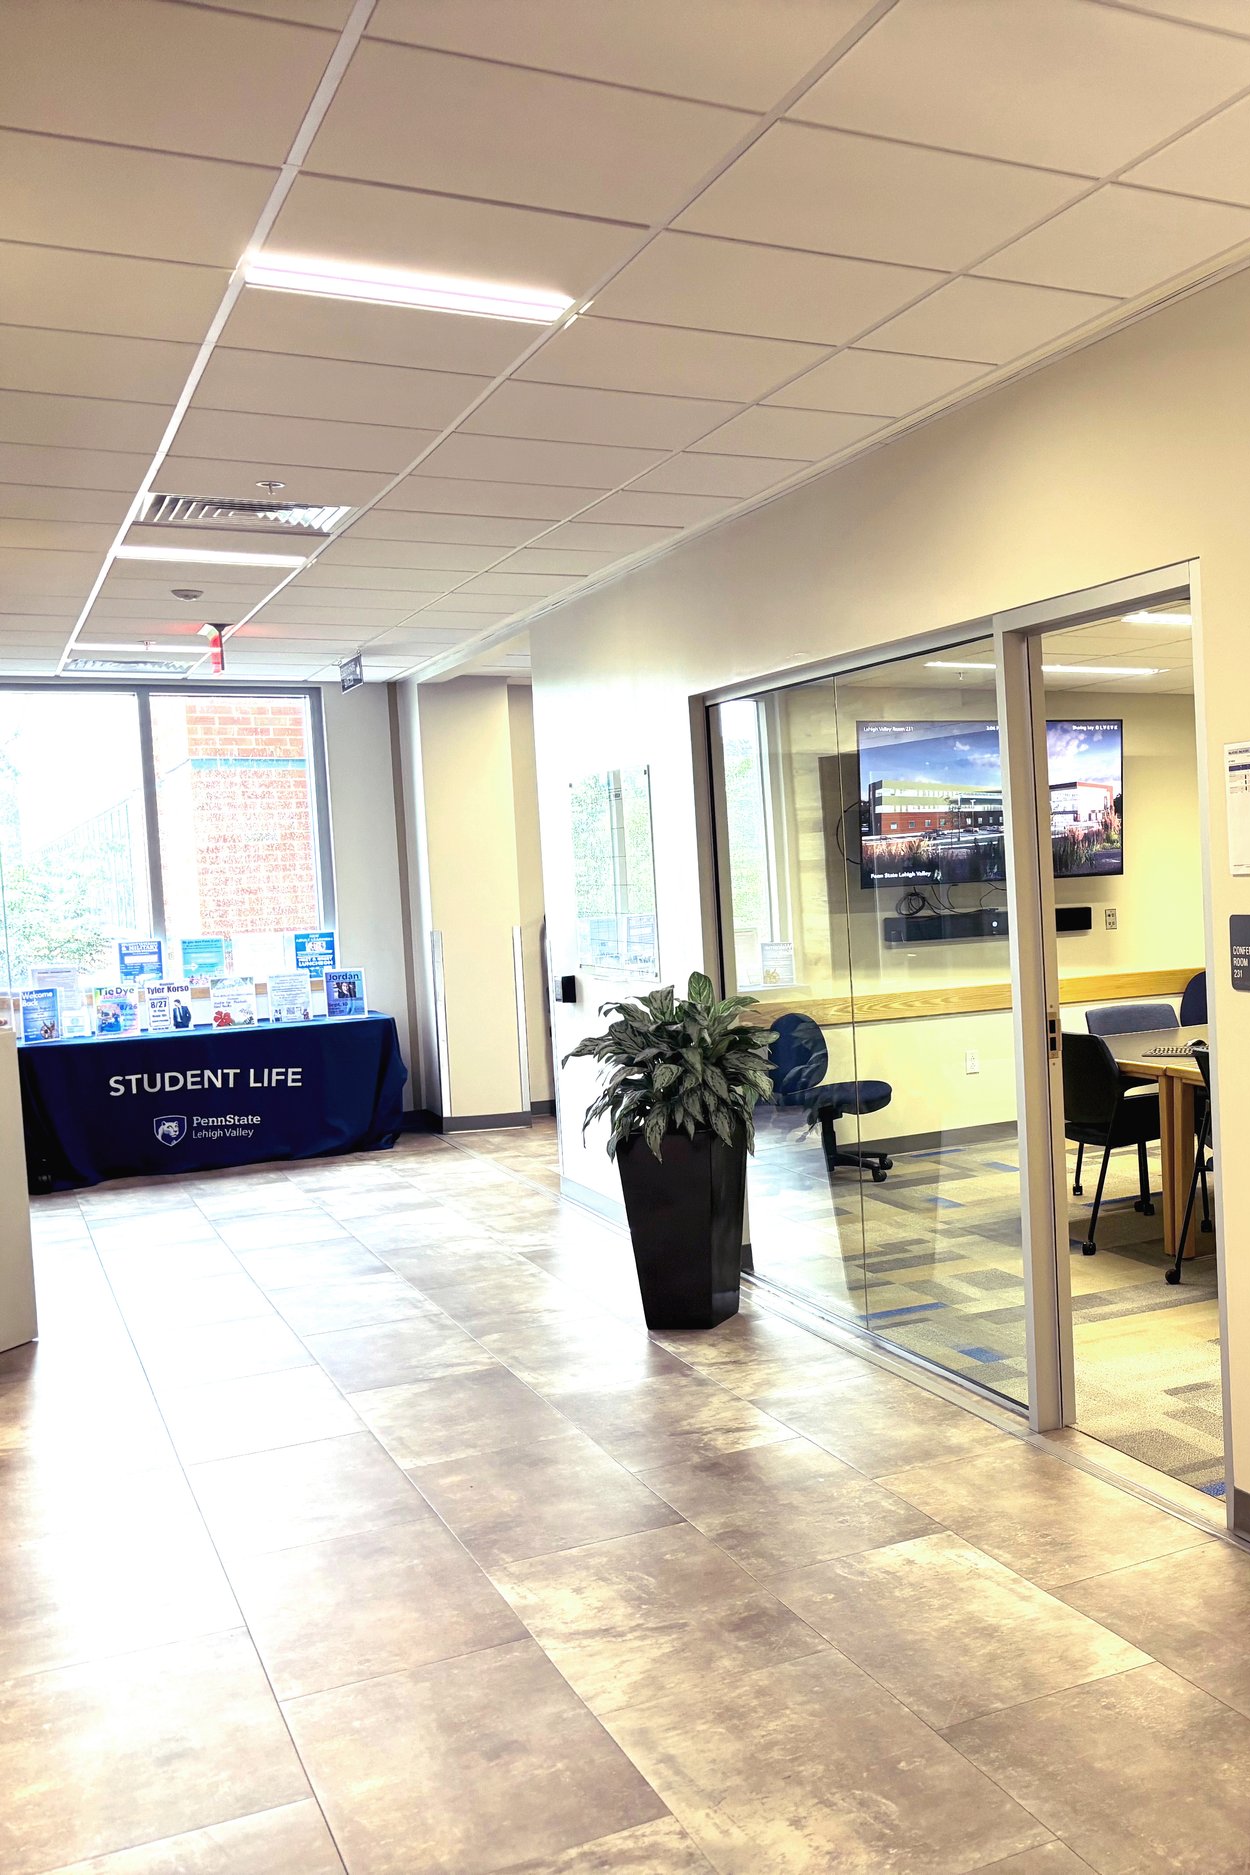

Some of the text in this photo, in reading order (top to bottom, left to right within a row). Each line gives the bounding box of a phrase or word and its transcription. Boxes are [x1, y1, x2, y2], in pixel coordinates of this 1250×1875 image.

[1233, 958, 1248, 966] ROOM
[1234, 970, 1242, 978] 231
[22, 991, 53, 1000] Welcome
[98, 988, 114, 996] Tie
[109, 1068, 302, 1097] STUDENT LIFE
[193, 1114, 261, 1126] PennState
[193, 1128, 254, 1139] Lehigh Valley
